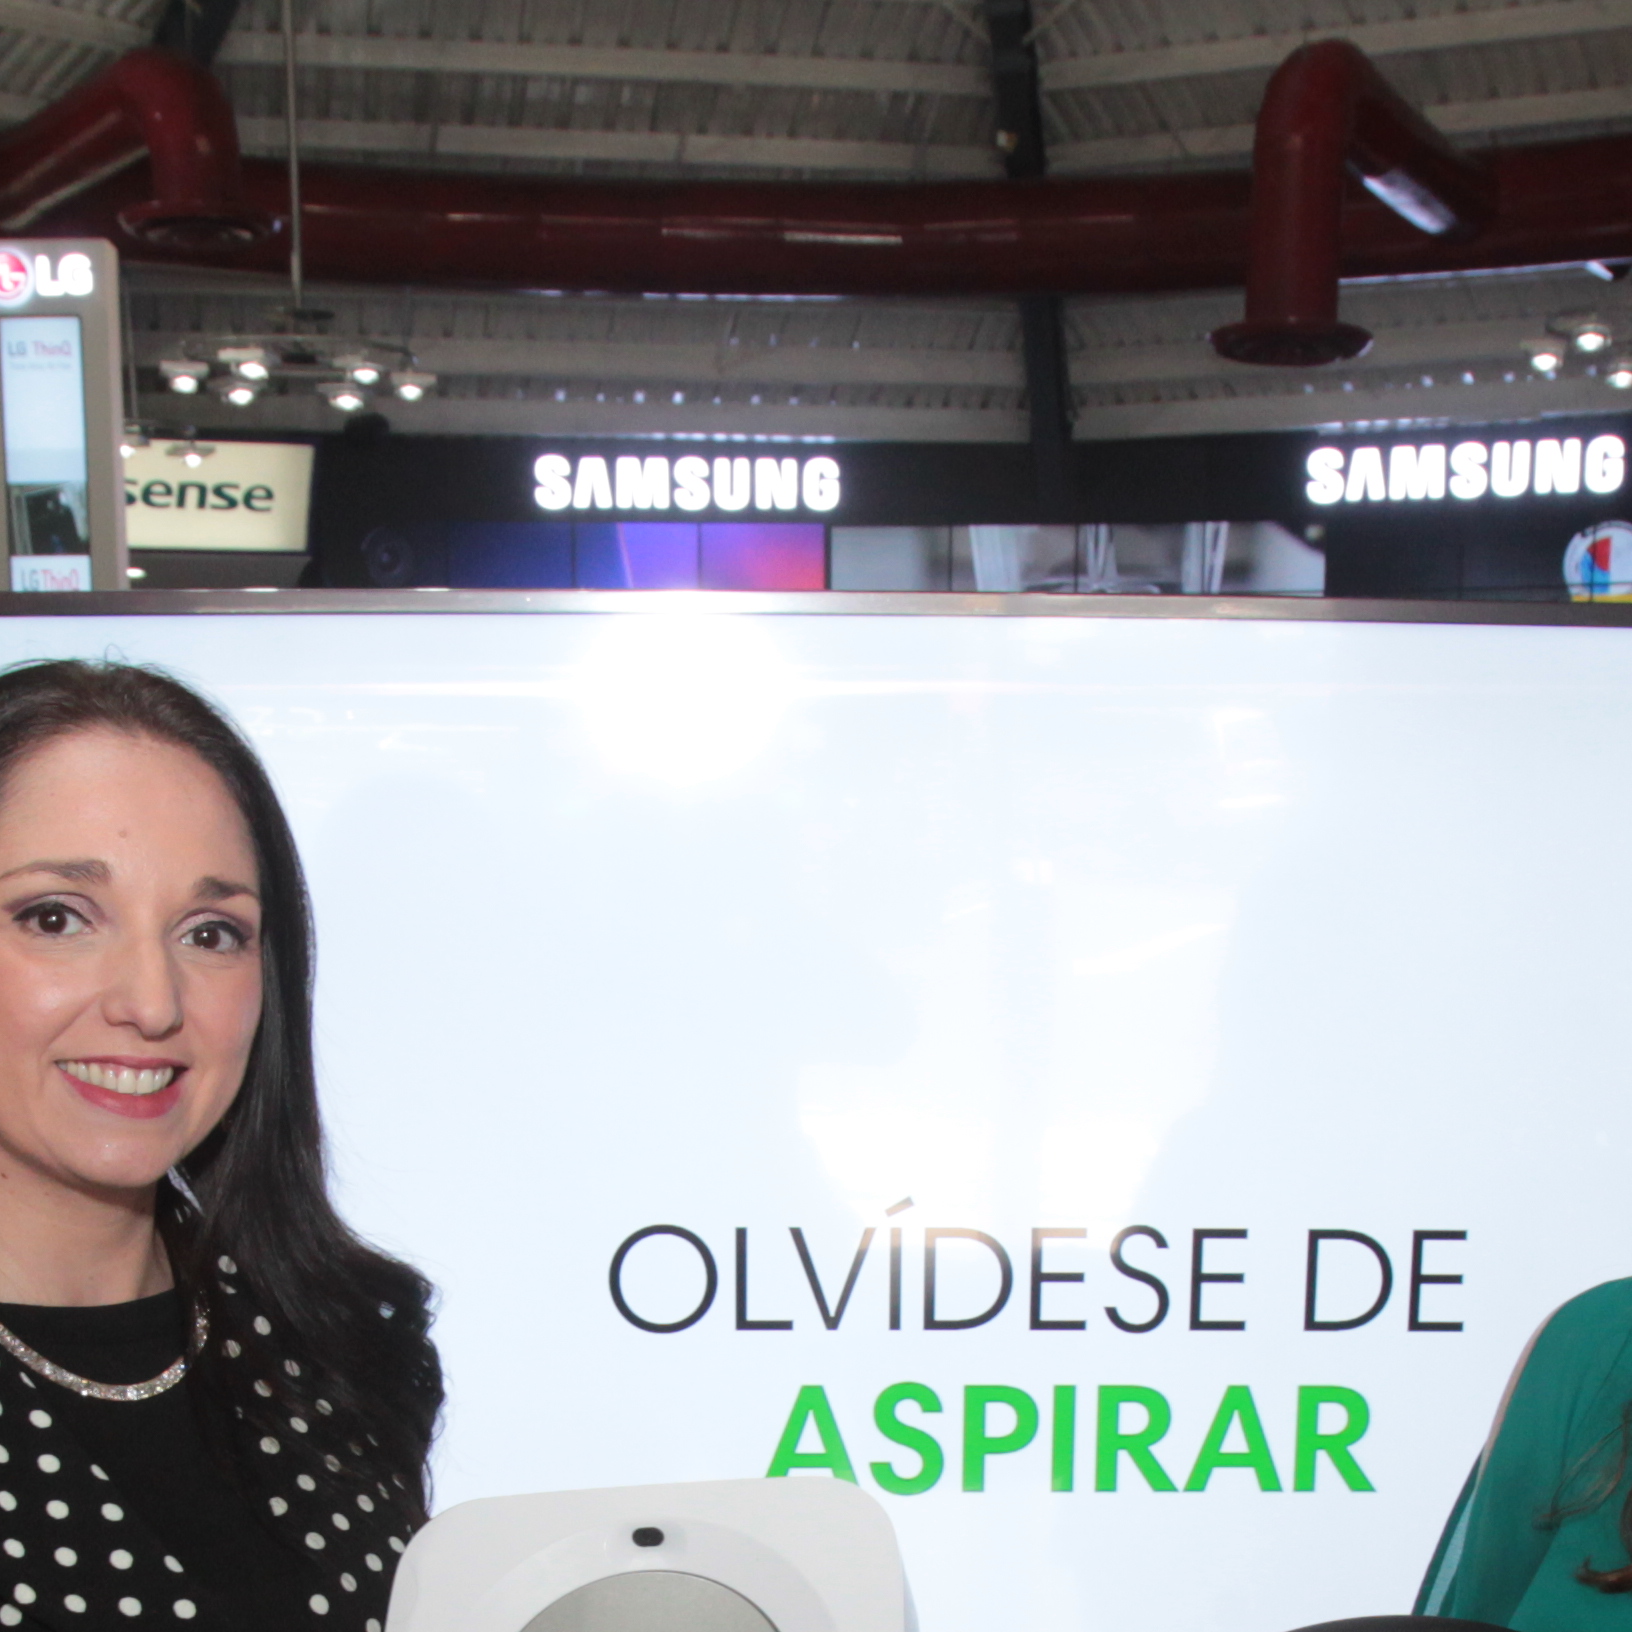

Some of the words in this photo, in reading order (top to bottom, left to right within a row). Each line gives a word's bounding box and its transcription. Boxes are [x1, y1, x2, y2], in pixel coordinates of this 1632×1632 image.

[35, 253, 93, 296] LG
[534, 453, 842, 512] SAMSUNG
[1305, 433, 1627, 505] SAMSUNG
[608, 1196, 1250, 1335] OLVÍDESE
[1303, 1228, 1469, 1333] DE
[764, 1381, 1377, 1497] ASPIRAR
